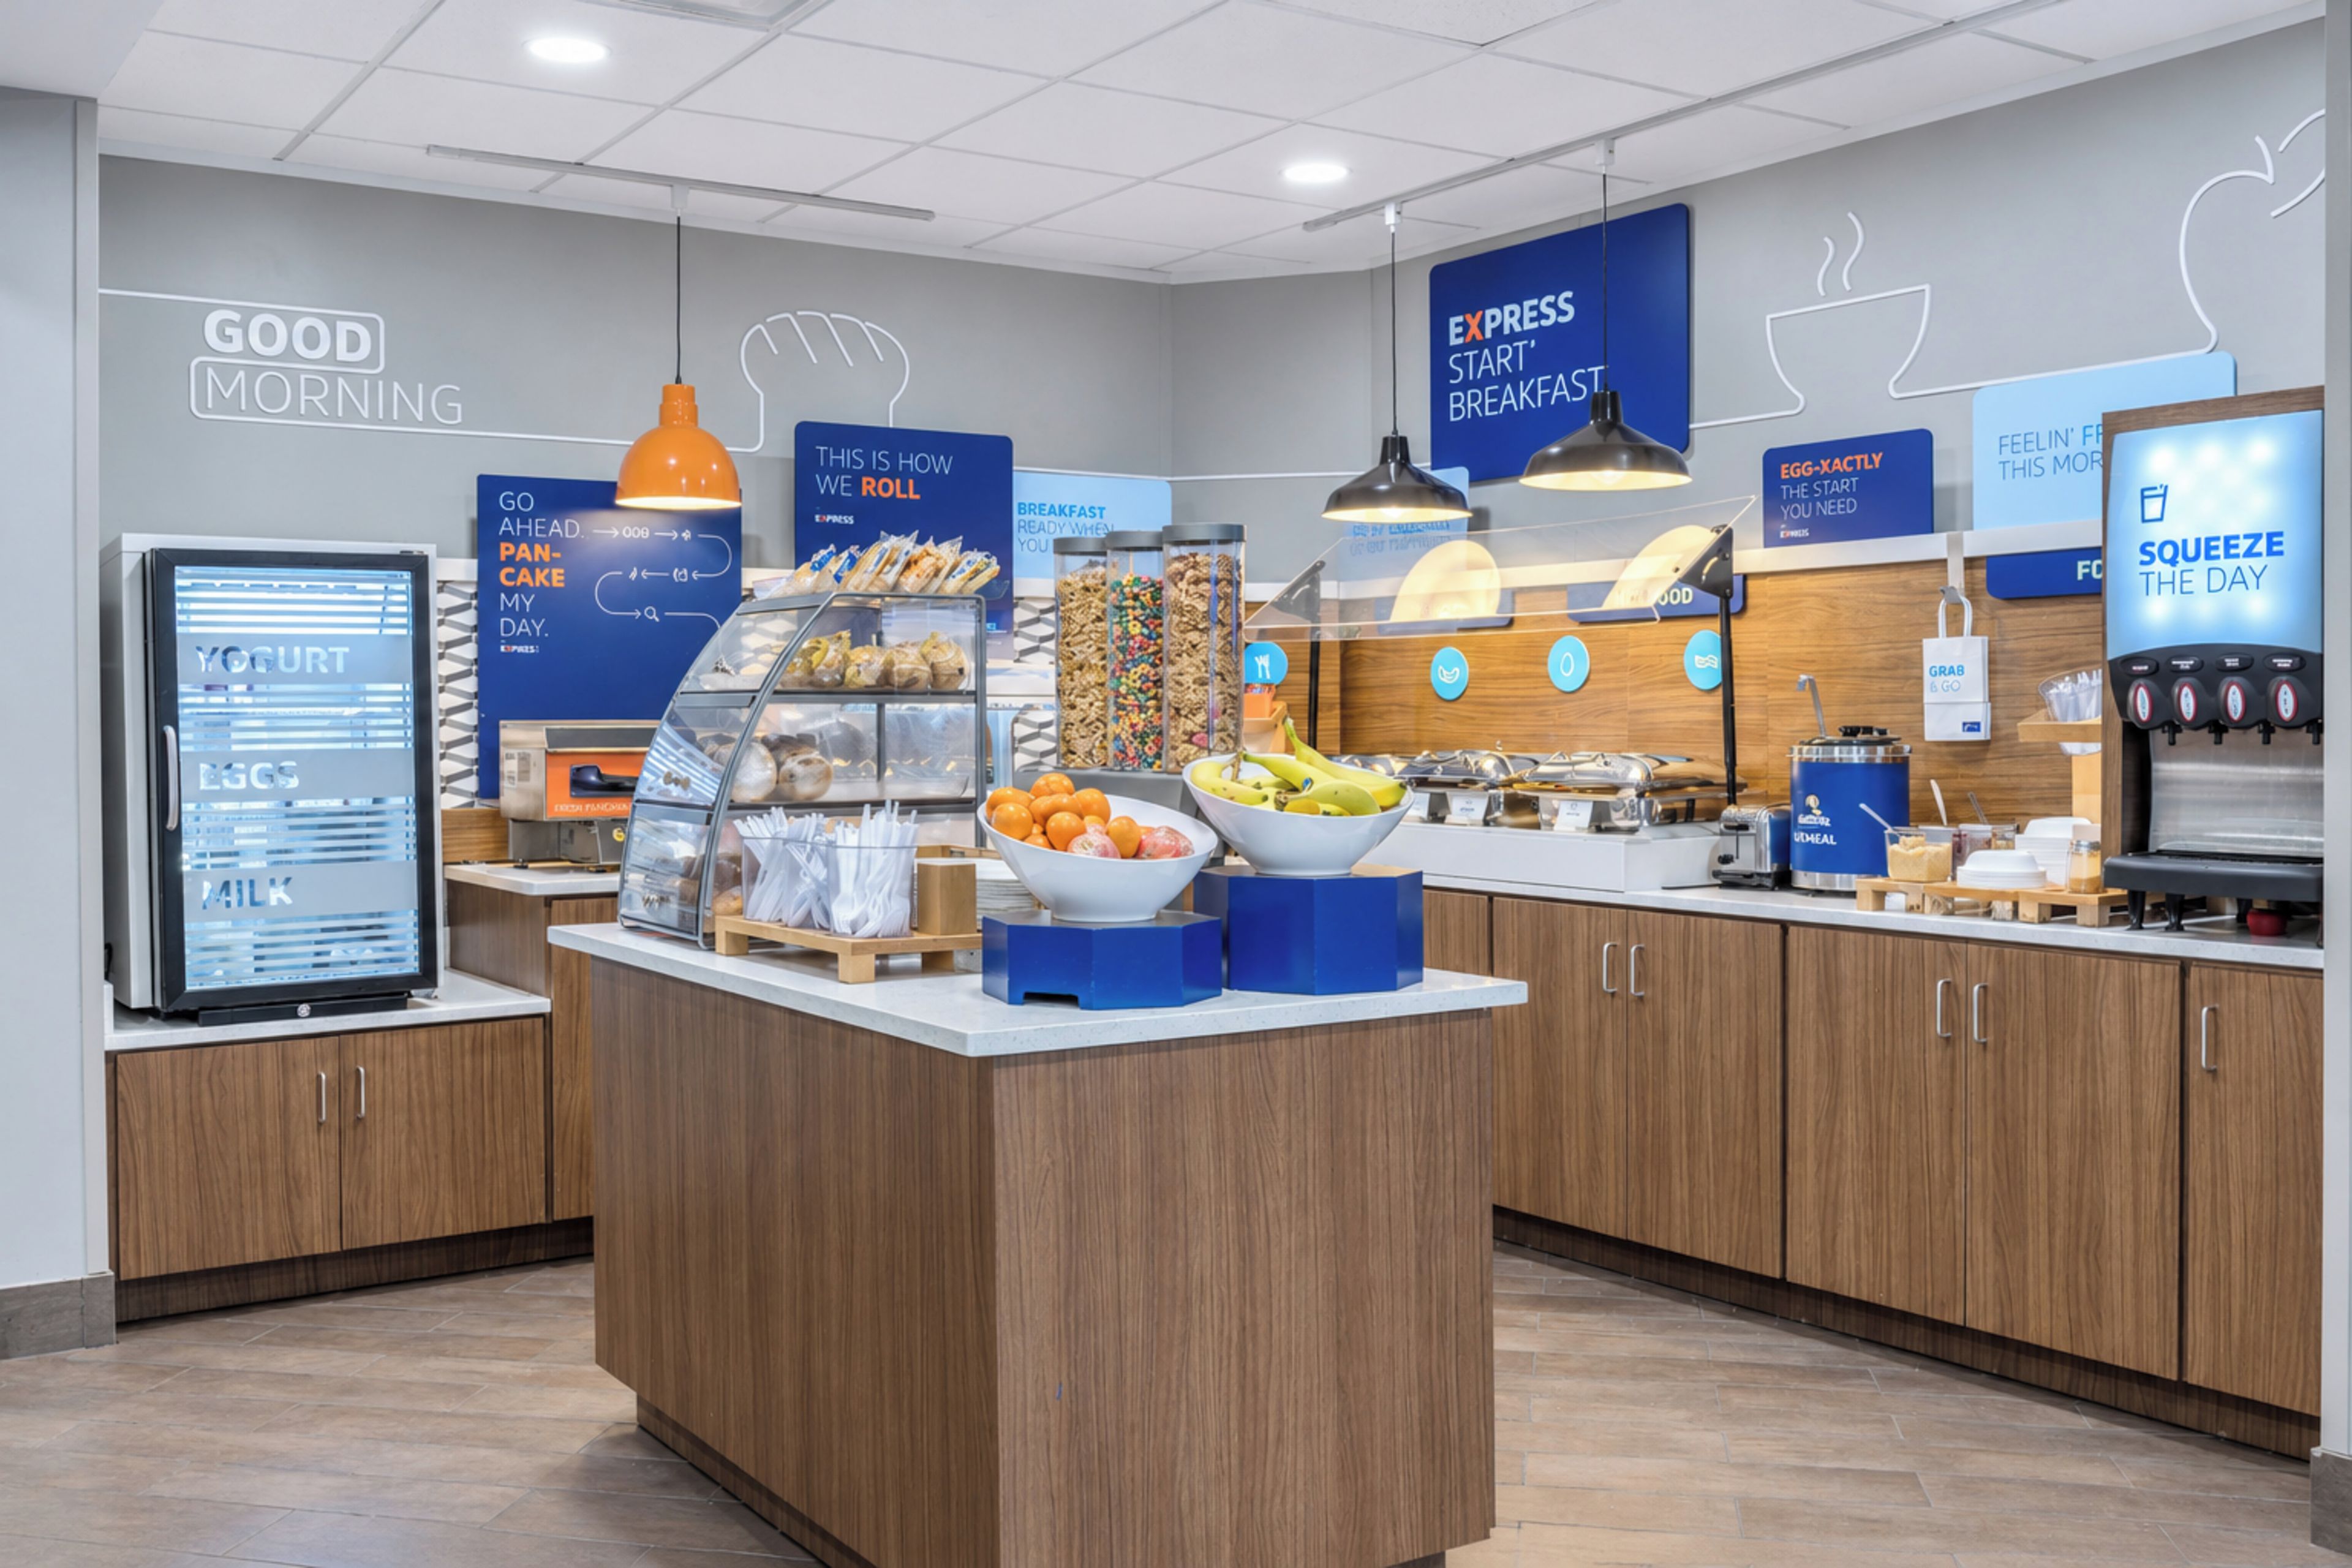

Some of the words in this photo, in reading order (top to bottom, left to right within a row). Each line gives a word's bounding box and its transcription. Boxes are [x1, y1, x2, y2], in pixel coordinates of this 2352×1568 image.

[1449, 290, 1575, 347] EXPRESS
[203, 309, 372, 363] GOOD
[206, 366, 462, 425] MORNING
[1449, 365, 1609, 423] BREAKFAST
[1999, 427, 2074, 455] FEELIN'
[815, 446, 864, 470] THIS
[872, 450, 890, 472] IS
[899, 452, 954, 475] HOW
[1781, 451, 1883, 479] EGG-XACTLY
[1999, 456, 2045, 480] THIS
[2053, 450, 2103, 475] MOR
[815, 474, 853, 497] WE
[861, 477, 921, 500] ROLL
[1781, 484, 1809, 500] THE
[1814, 478, 1859, 497] START
[499, 491, 535, 512] GO
[1017, 502, 1106, 519] BREAKFAST
[1781, 502, 1812, 521] YOU
[1816, 498, 1858, 516] NEED
[1017, 519, 1066, 535] READY
[1068, 522, 1114, 537] WHEN
[500, 541, 562, 562] PAN-
[1018, 537, 1049, 552] YOU
[2139, 531, 2285, 567] SQUEEZE
[499, 567, 565, 587] CAKE
[2139, 569, 2195, 597] THE
[2207, 564, 2268, 594] DAY
[500, 593, 535, 612] MY
[500, 617, 549, 638] DAY.
[195, 645, 350, 674] YOGURT
[1929, 664, 1965, 677] GRAB
[1941, 679, 1961, 692] GO
[198, 761, 300, 791] EGGS
[202, 876, 293, 910] MILK
